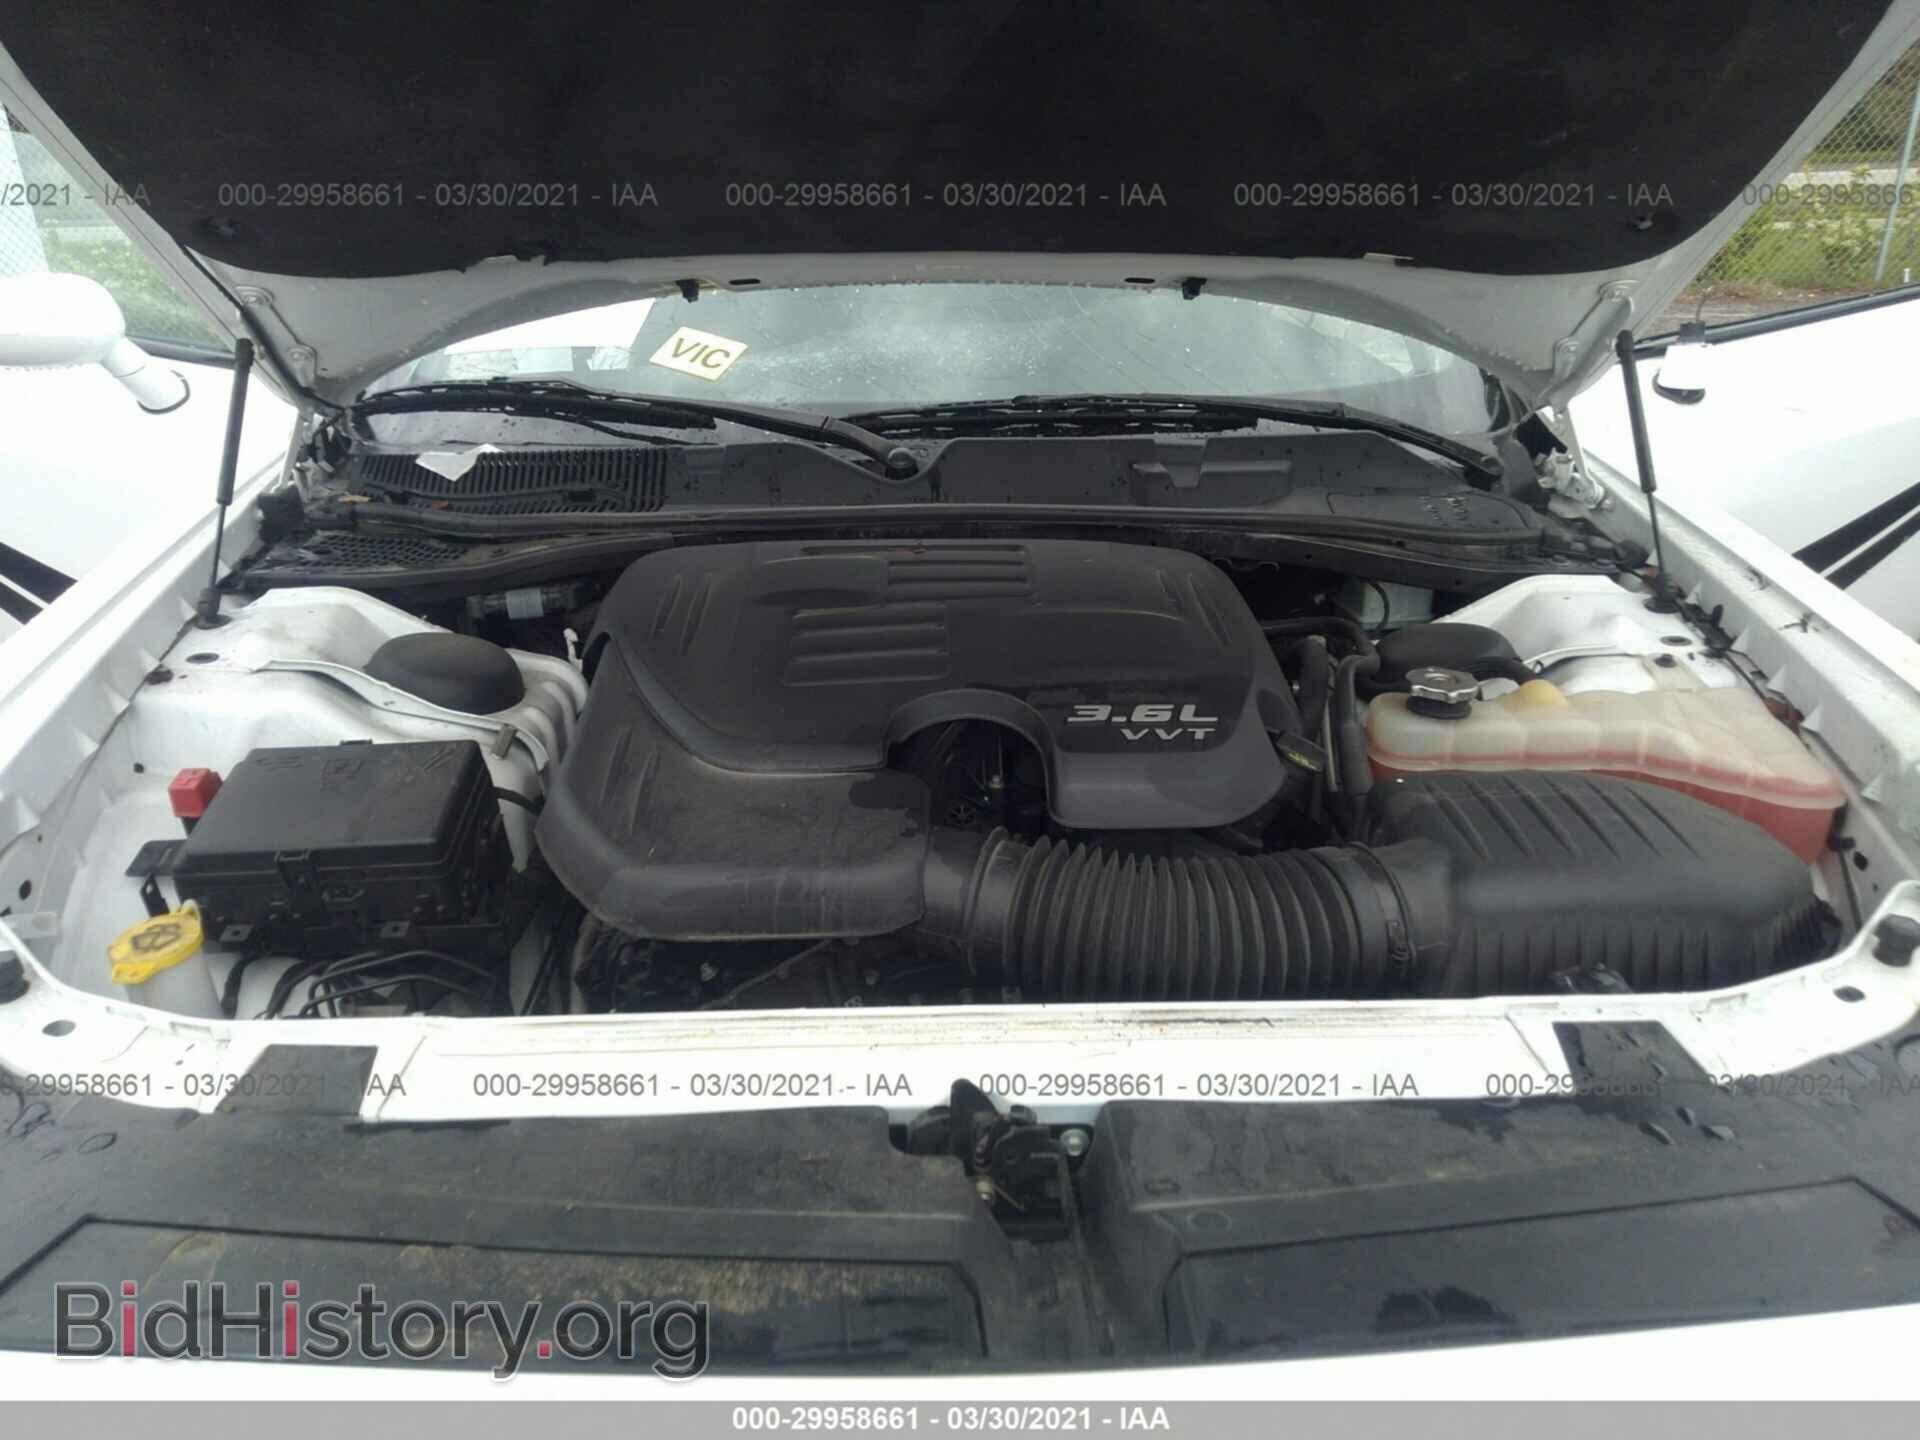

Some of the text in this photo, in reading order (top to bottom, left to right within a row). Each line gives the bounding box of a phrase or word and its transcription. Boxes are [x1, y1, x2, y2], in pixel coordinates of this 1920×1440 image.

[672, 338, 731, 369] VIC
[1067, 704, 1219, 723] 3.6L
[1120, 728, 1216, 741] VVT
